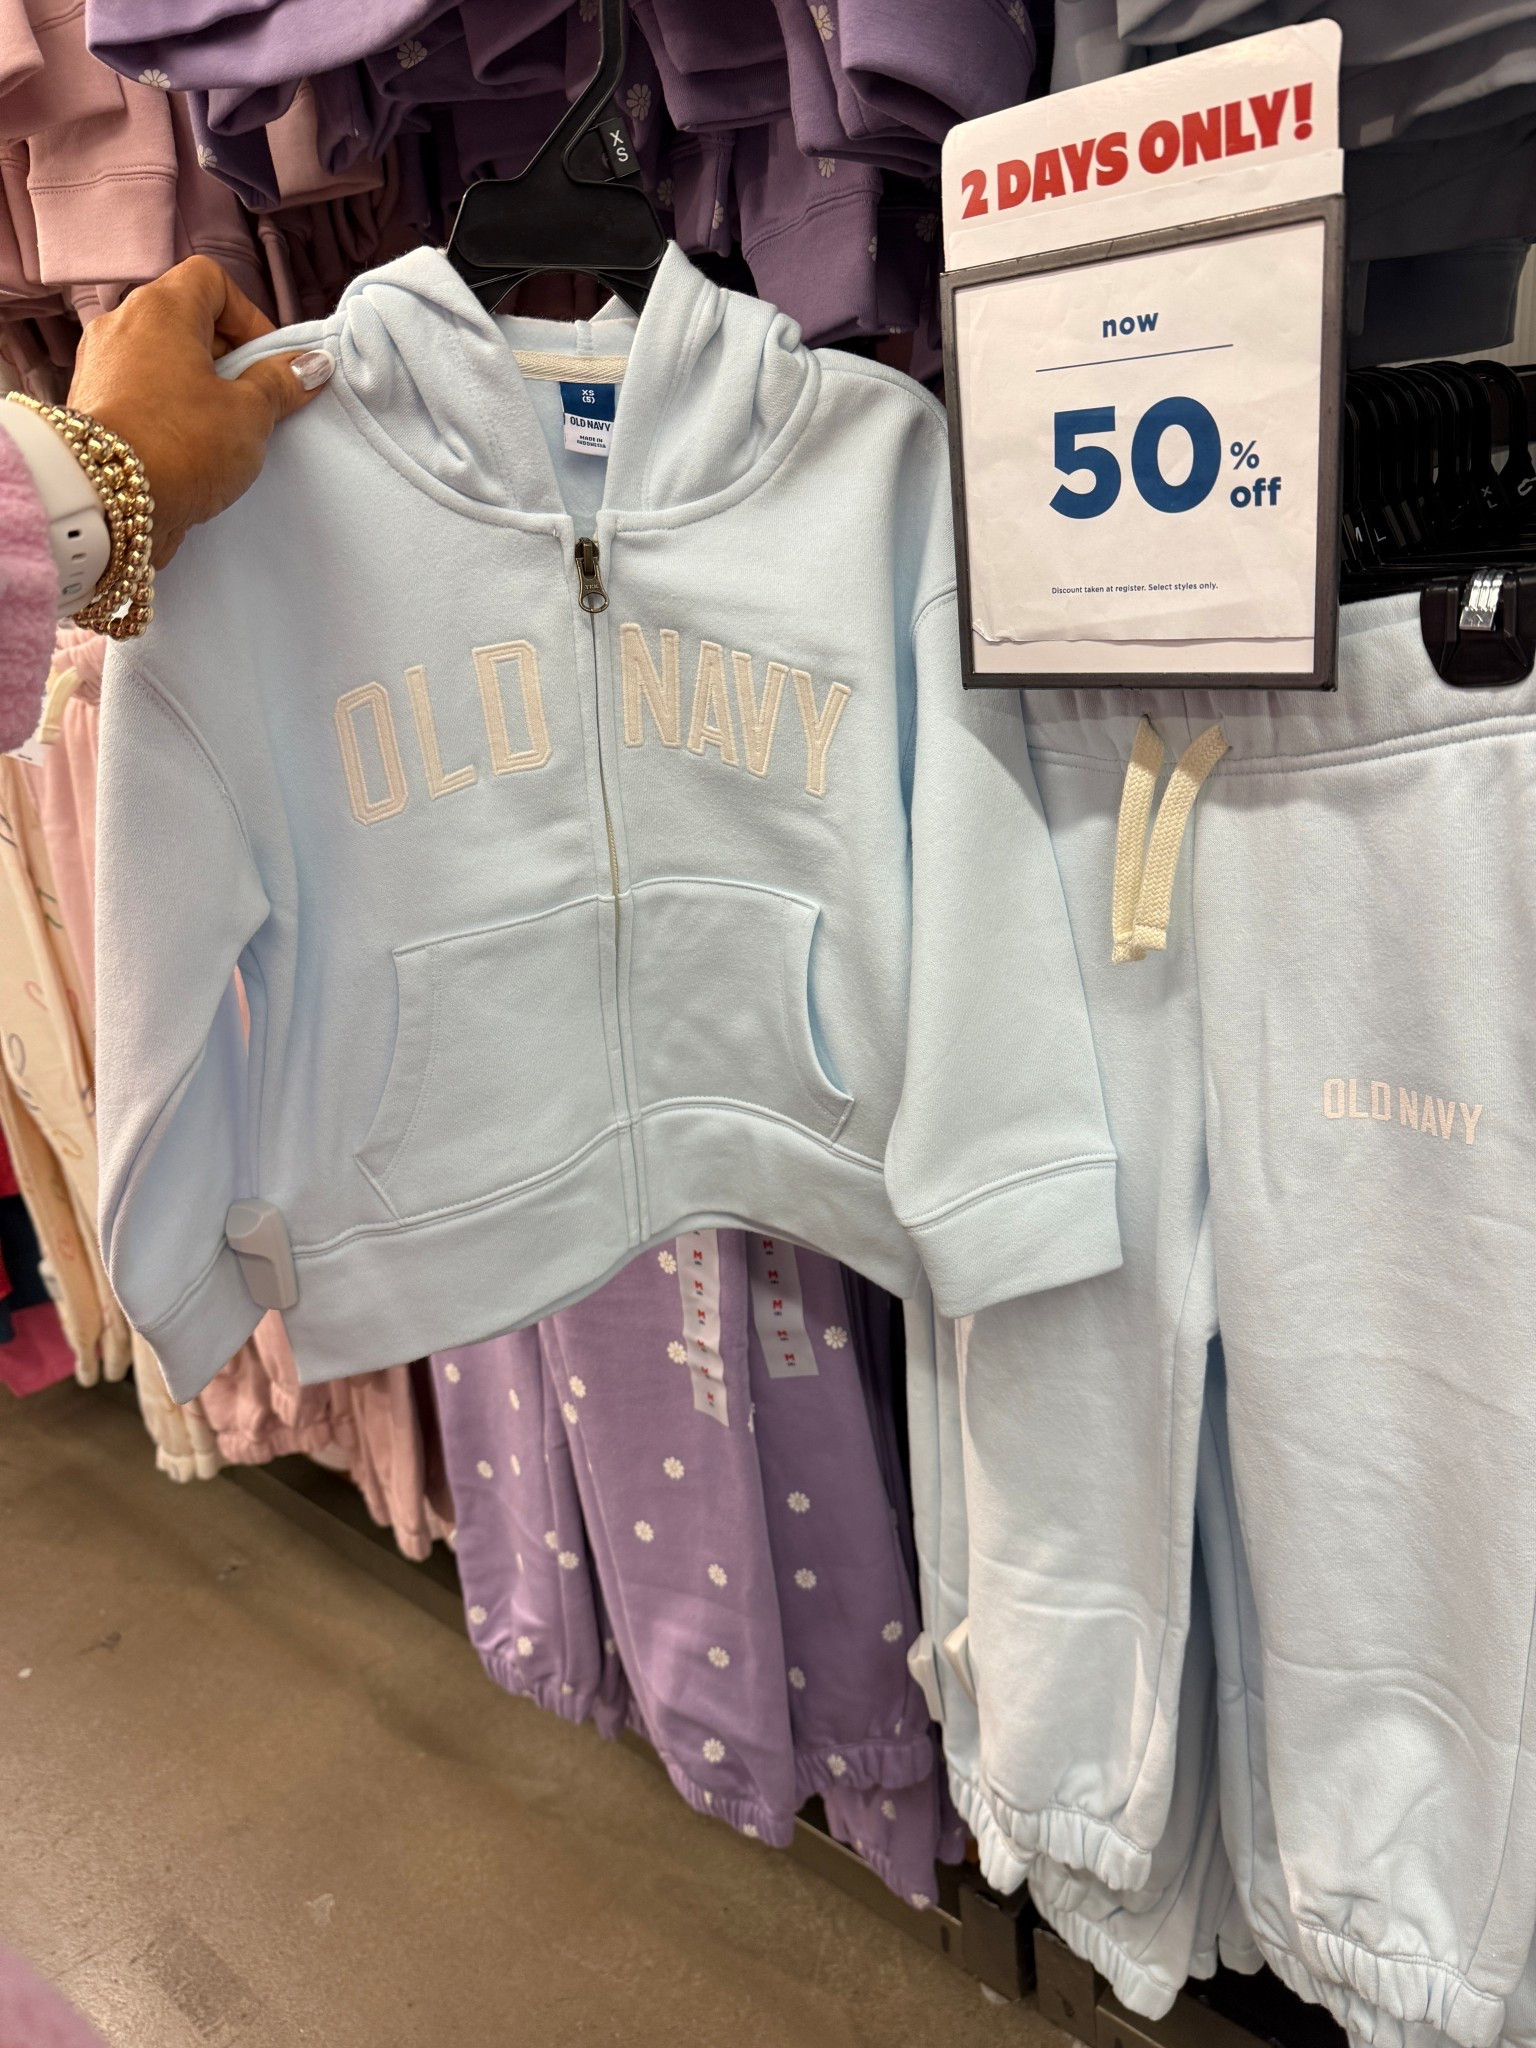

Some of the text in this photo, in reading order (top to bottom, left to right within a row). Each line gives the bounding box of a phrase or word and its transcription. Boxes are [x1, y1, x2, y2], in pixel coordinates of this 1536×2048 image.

[609, 129, 629, 162] XS
[961, 82, 1313, 220] 2 DAYS ONLY!
[1102, 312, 1159, 338] now
[582, 396, 596, 404] (5)
[570, 416, 611, 432] OLD NAVY
[577, 439, 606, 449] INDONESIA
[579, 435, 596, 443] MADE
[1049, 396, 1222, 519] 50
[1230, 476, 1282, 508] off
[1051, 581, 1219, 594] Discount taken at register. Select styles only.
[335, 622, 852, 826] OLD NAVY
[1323, 1078, 1484, 1146] OLD NAVY
